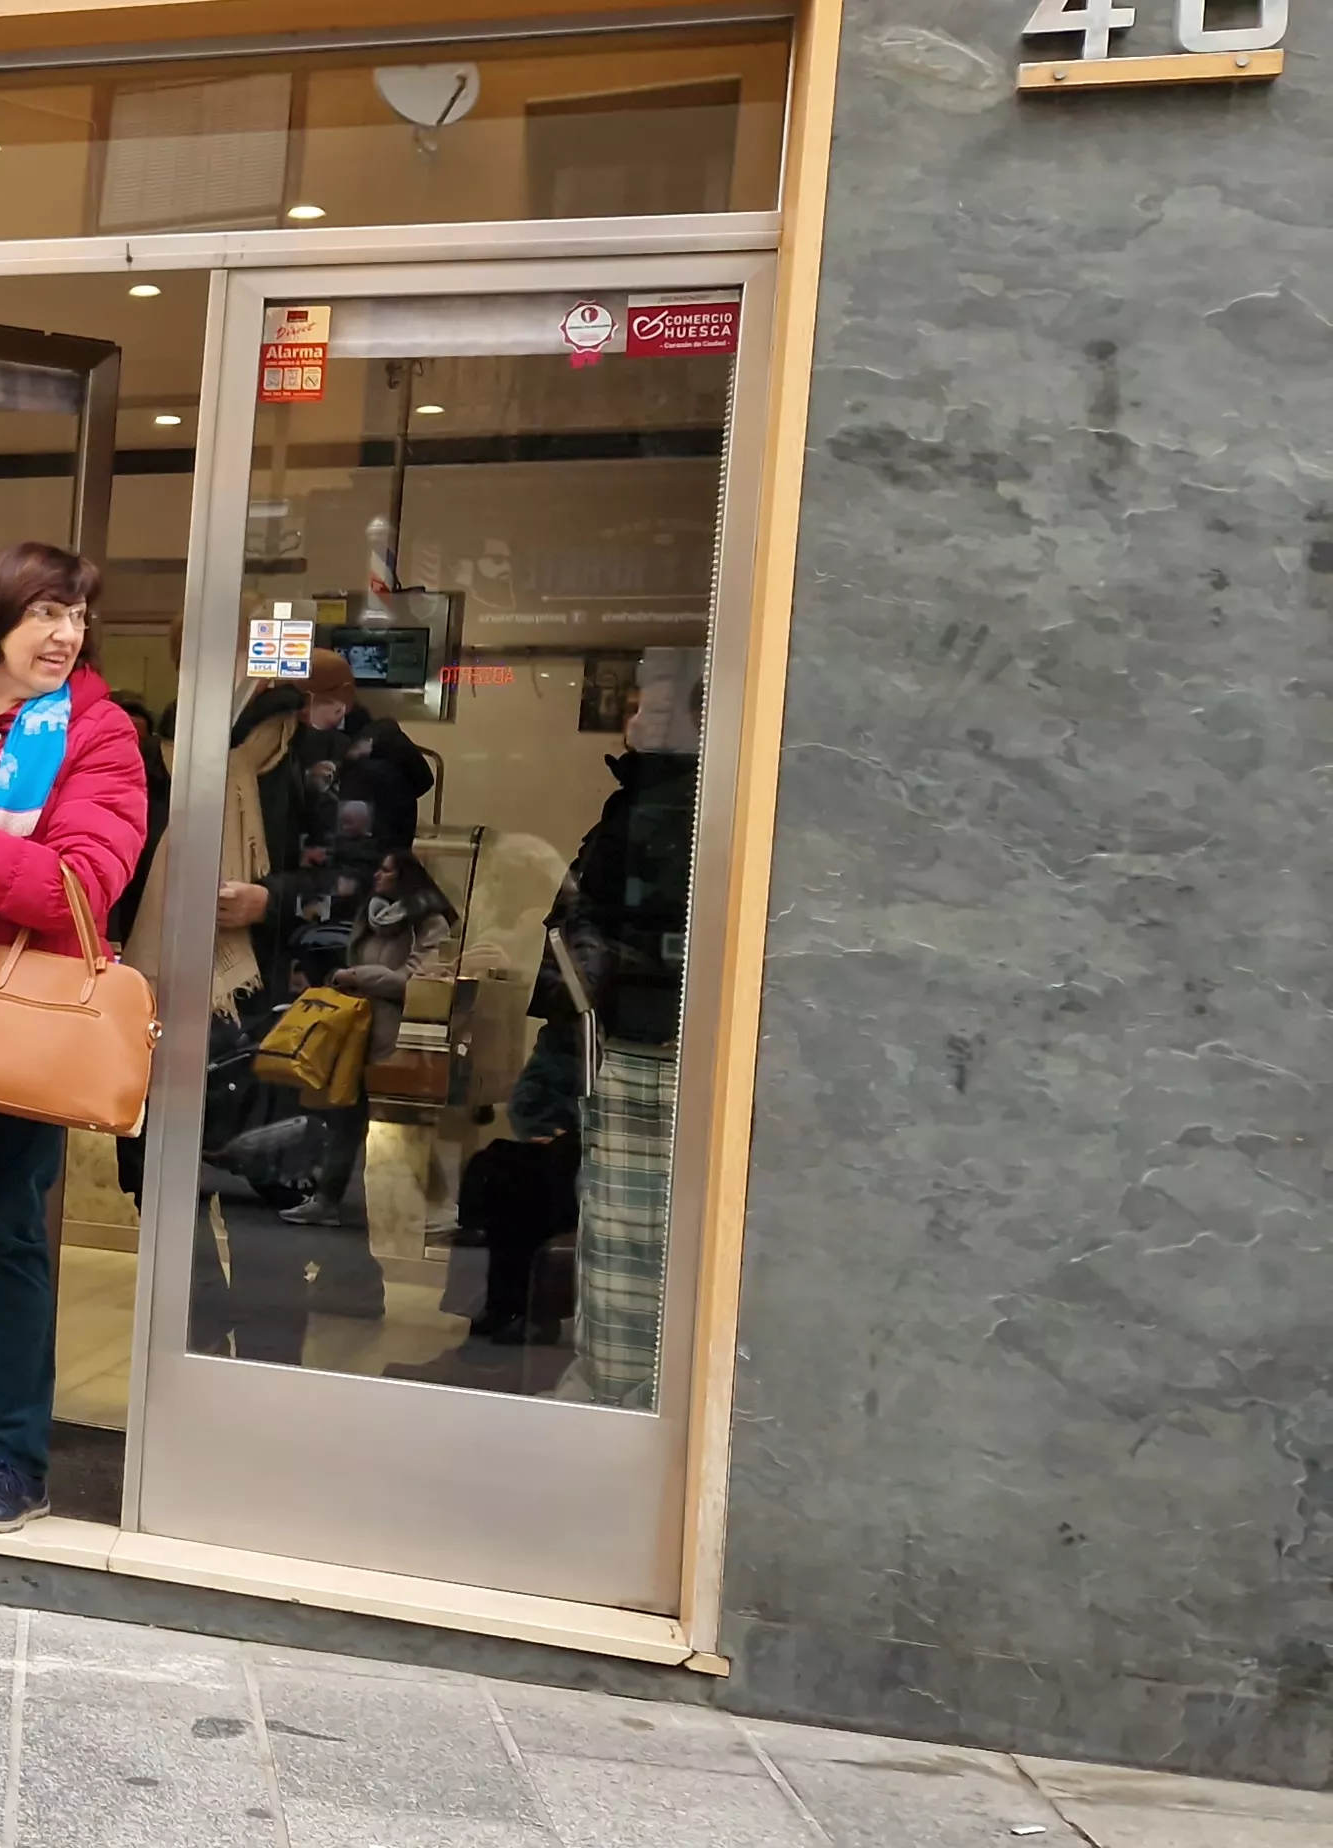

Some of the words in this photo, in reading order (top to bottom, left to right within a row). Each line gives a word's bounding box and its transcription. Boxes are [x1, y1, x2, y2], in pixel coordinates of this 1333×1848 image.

[665, 312, 733, 326] COMERCIO
[664, 325, 732, 339] HUESCA
[266, 345, 324, 359] Alarma
